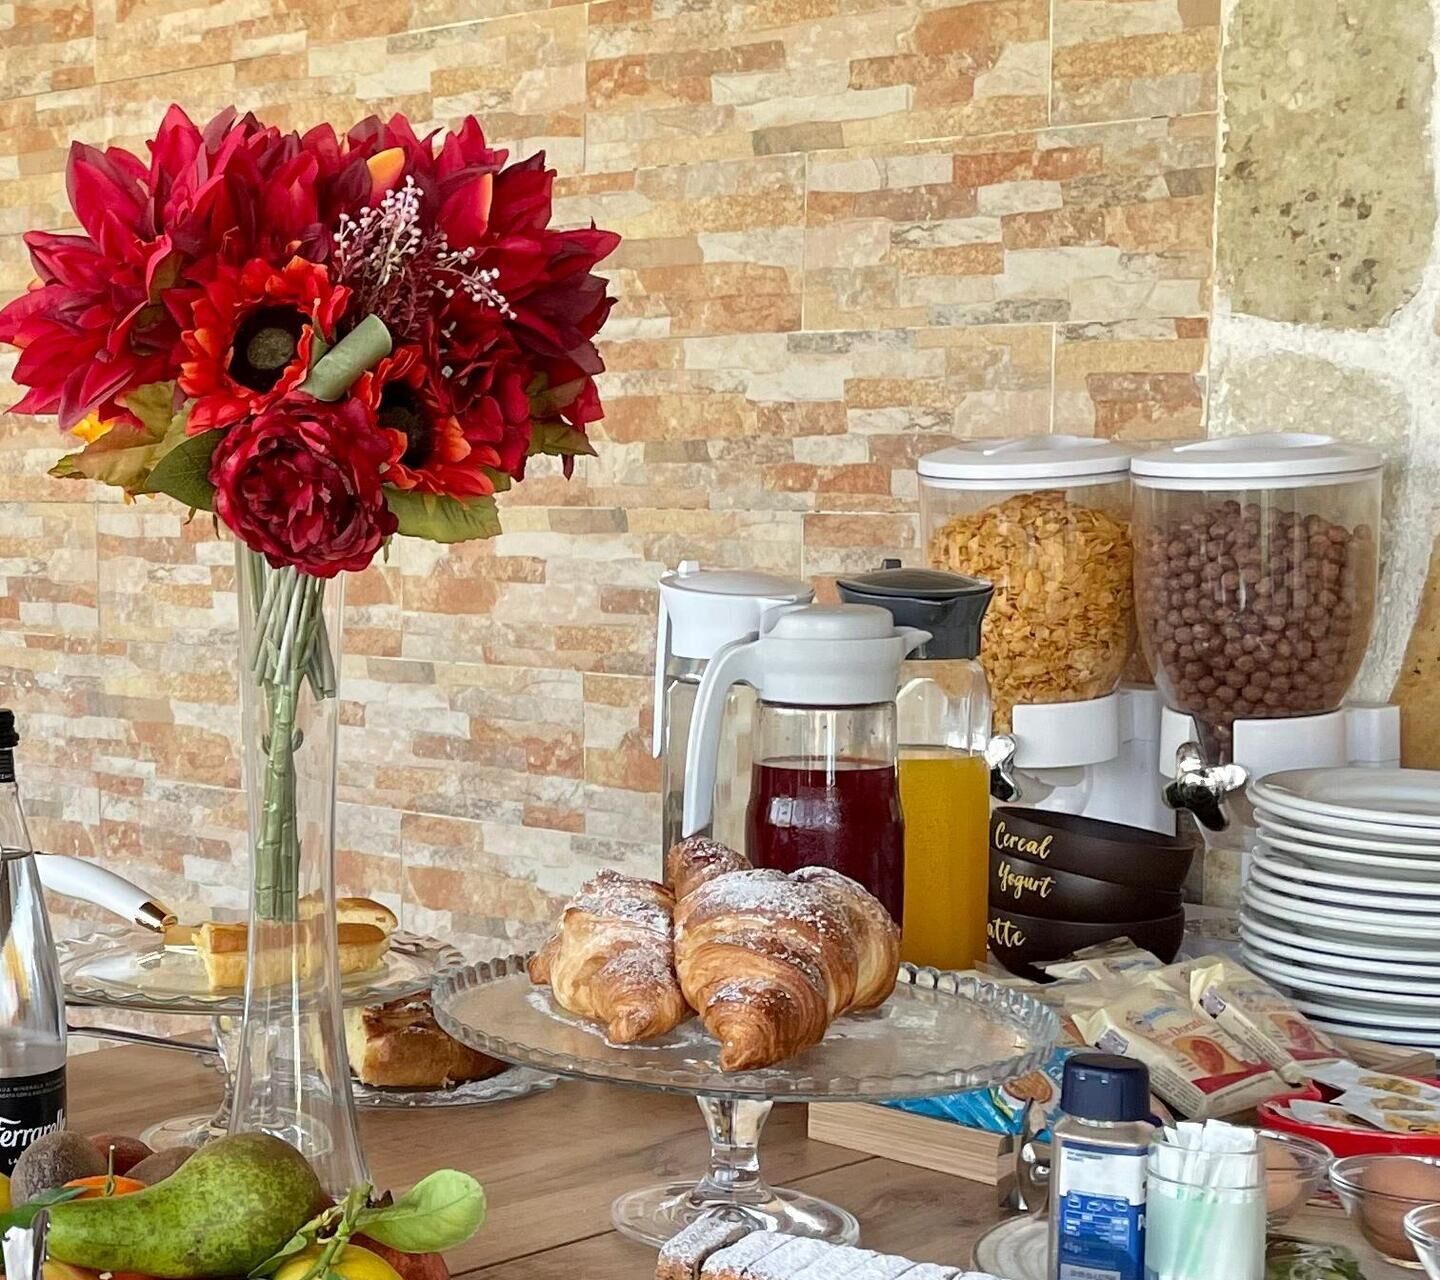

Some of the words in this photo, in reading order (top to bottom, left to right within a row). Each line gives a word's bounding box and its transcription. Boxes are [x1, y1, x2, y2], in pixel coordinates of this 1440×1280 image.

[995, 821, 1053, 859] Cereal
[998, 861, 1056, 899] Yogurt
[987, 918, 1026, 949] atte
